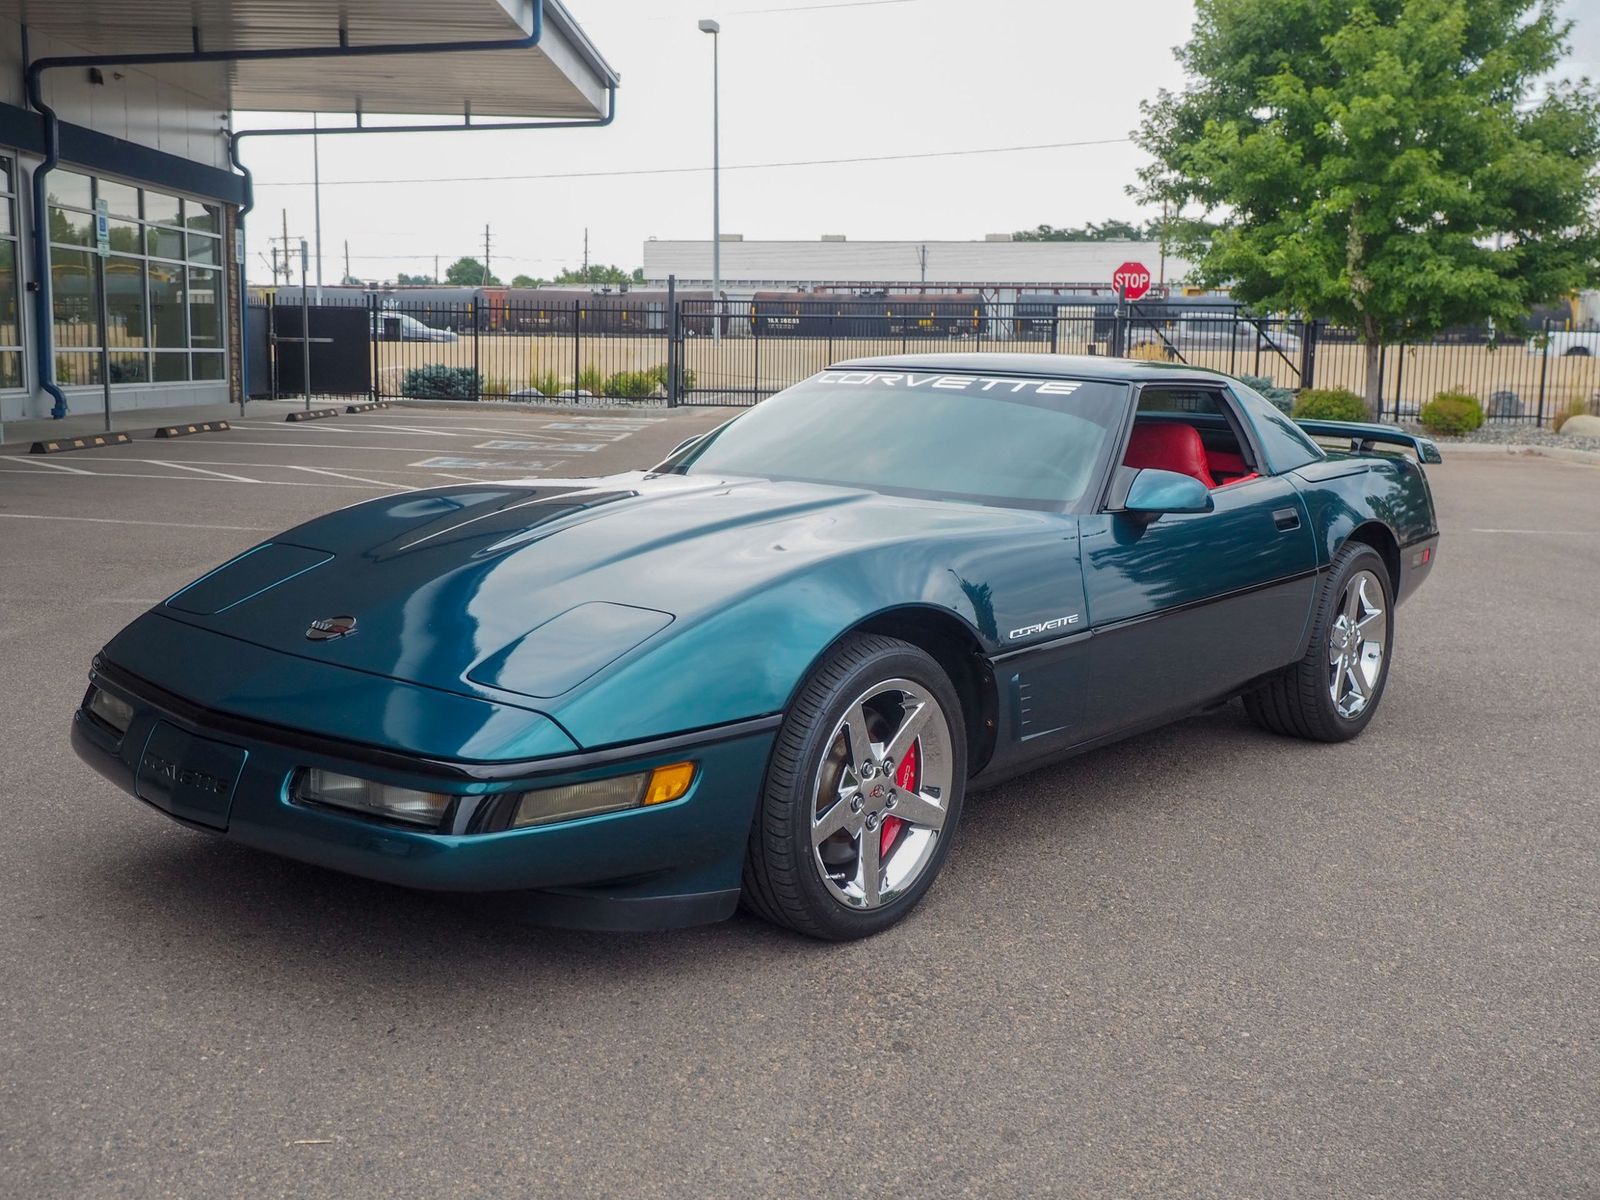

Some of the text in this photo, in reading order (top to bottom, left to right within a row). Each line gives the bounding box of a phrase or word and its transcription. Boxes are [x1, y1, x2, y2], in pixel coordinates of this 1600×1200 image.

[1115, 272, 1149, 289] STOP
[818, 370, 1083, 396] CORVETTE
[1009, 613, 1079, 640] CORVETTE
